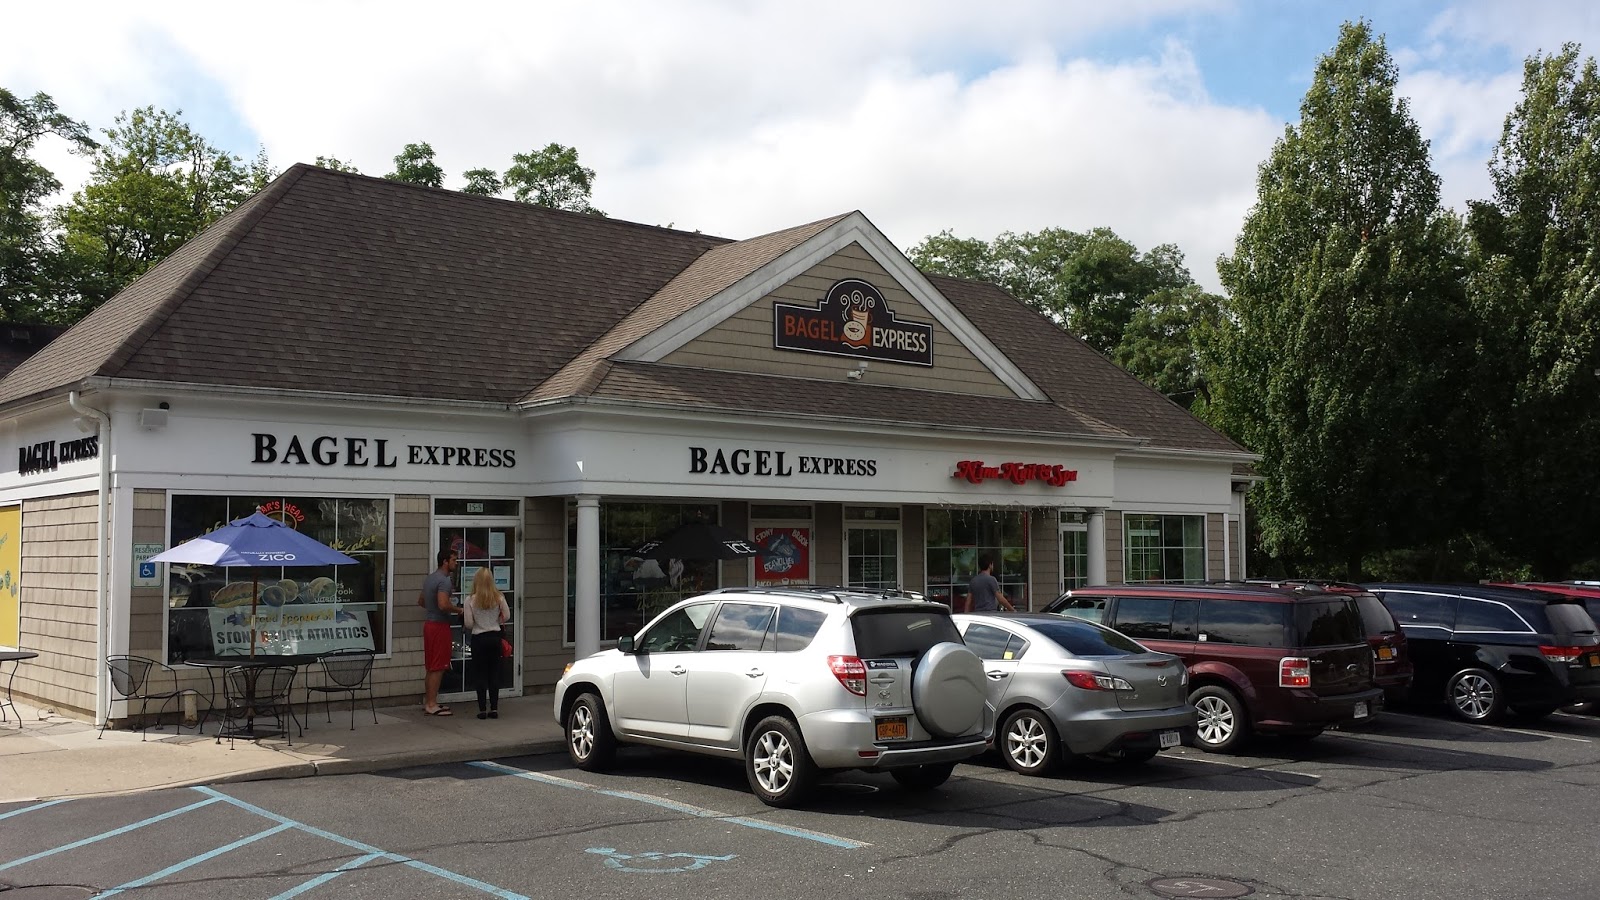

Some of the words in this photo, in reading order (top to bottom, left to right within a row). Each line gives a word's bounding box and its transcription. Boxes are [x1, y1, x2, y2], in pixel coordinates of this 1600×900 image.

[784, 315, 839, 342] BAGEL
[872, 326, 927, 353] EXPRESS
[251, 433, 398, 468] BAGEL
[406, 444, 517, 469] EXPRESS
[688, 446, 793, 477] BAGEL
[798, 455, 877, 477] EXPRESS
[260, 501, 280, 514] AR'S
[755, 528, 774, 543] STONY
[791, 529, 809, 547] BROOK
[258, 553, 296, 561] ZICO
[217, 630, 258, 645] STON
